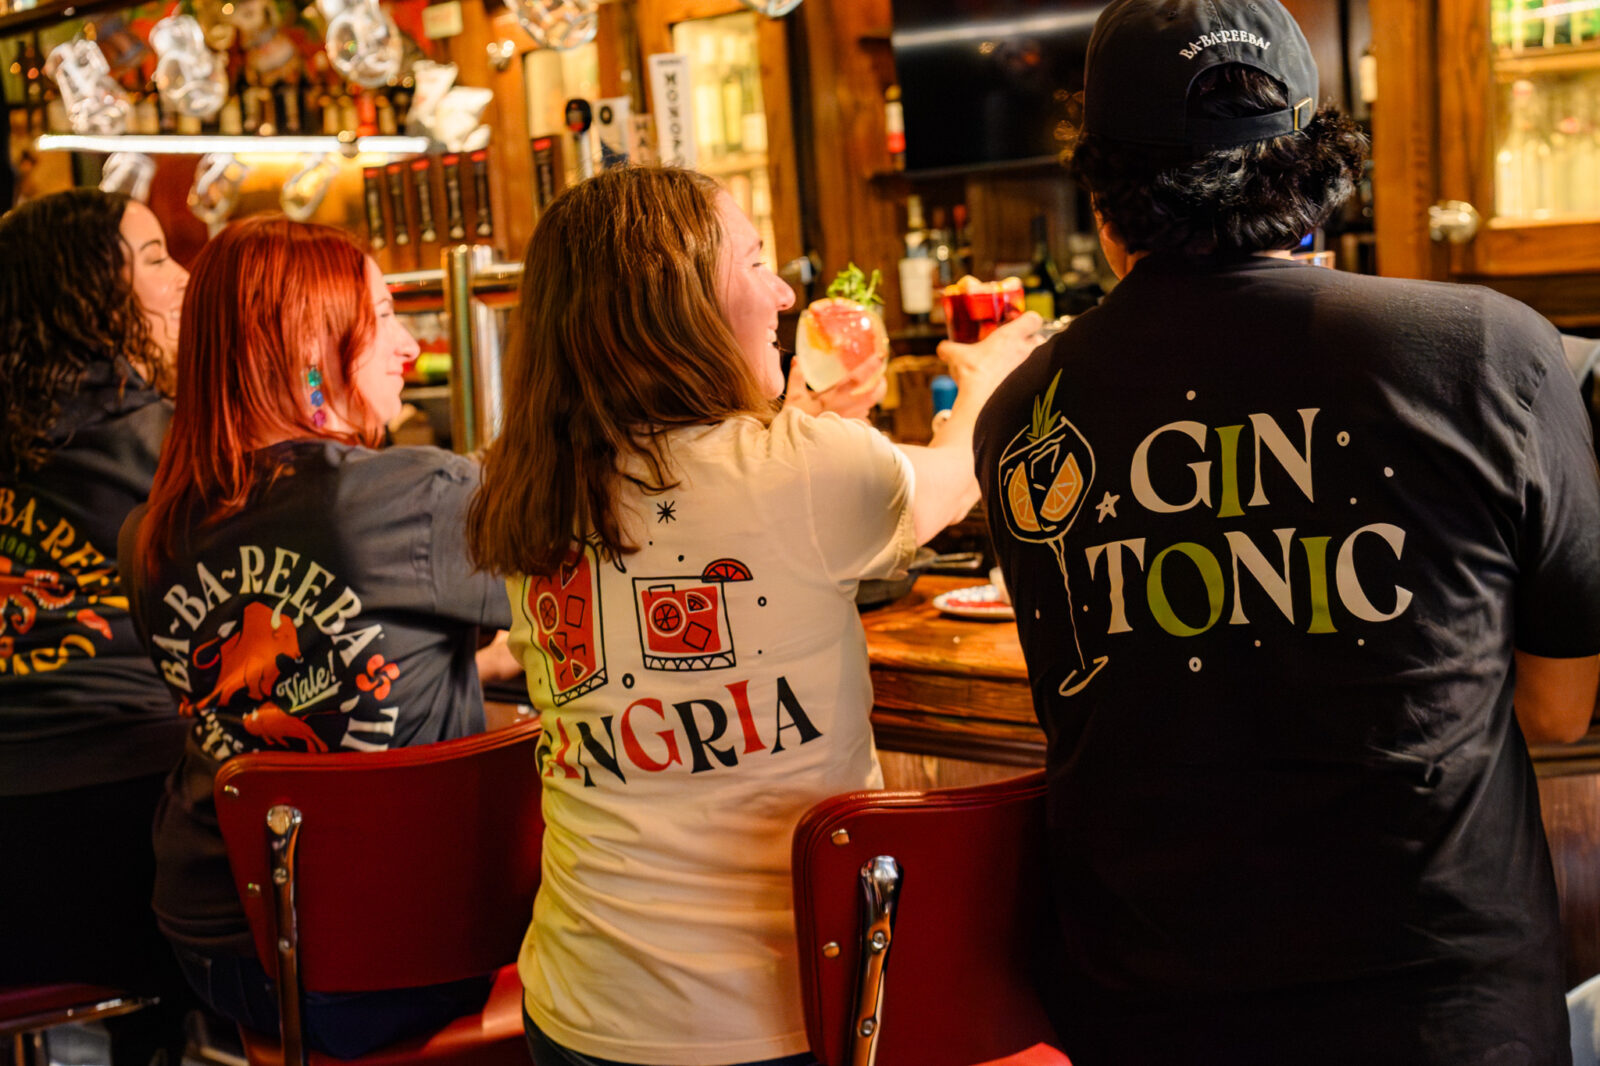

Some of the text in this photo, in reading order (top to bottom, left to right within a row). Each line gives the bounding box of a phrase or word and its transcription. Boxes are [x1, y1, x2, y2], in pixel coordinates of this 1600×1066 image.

[1179, 29, 1271, 60] BA-BA-REEBA!
[1130, 408, 1321, 518] GIN
[1085, 522, 1413, 637] TONIC
[276, 650, 336, 703] Vale!
